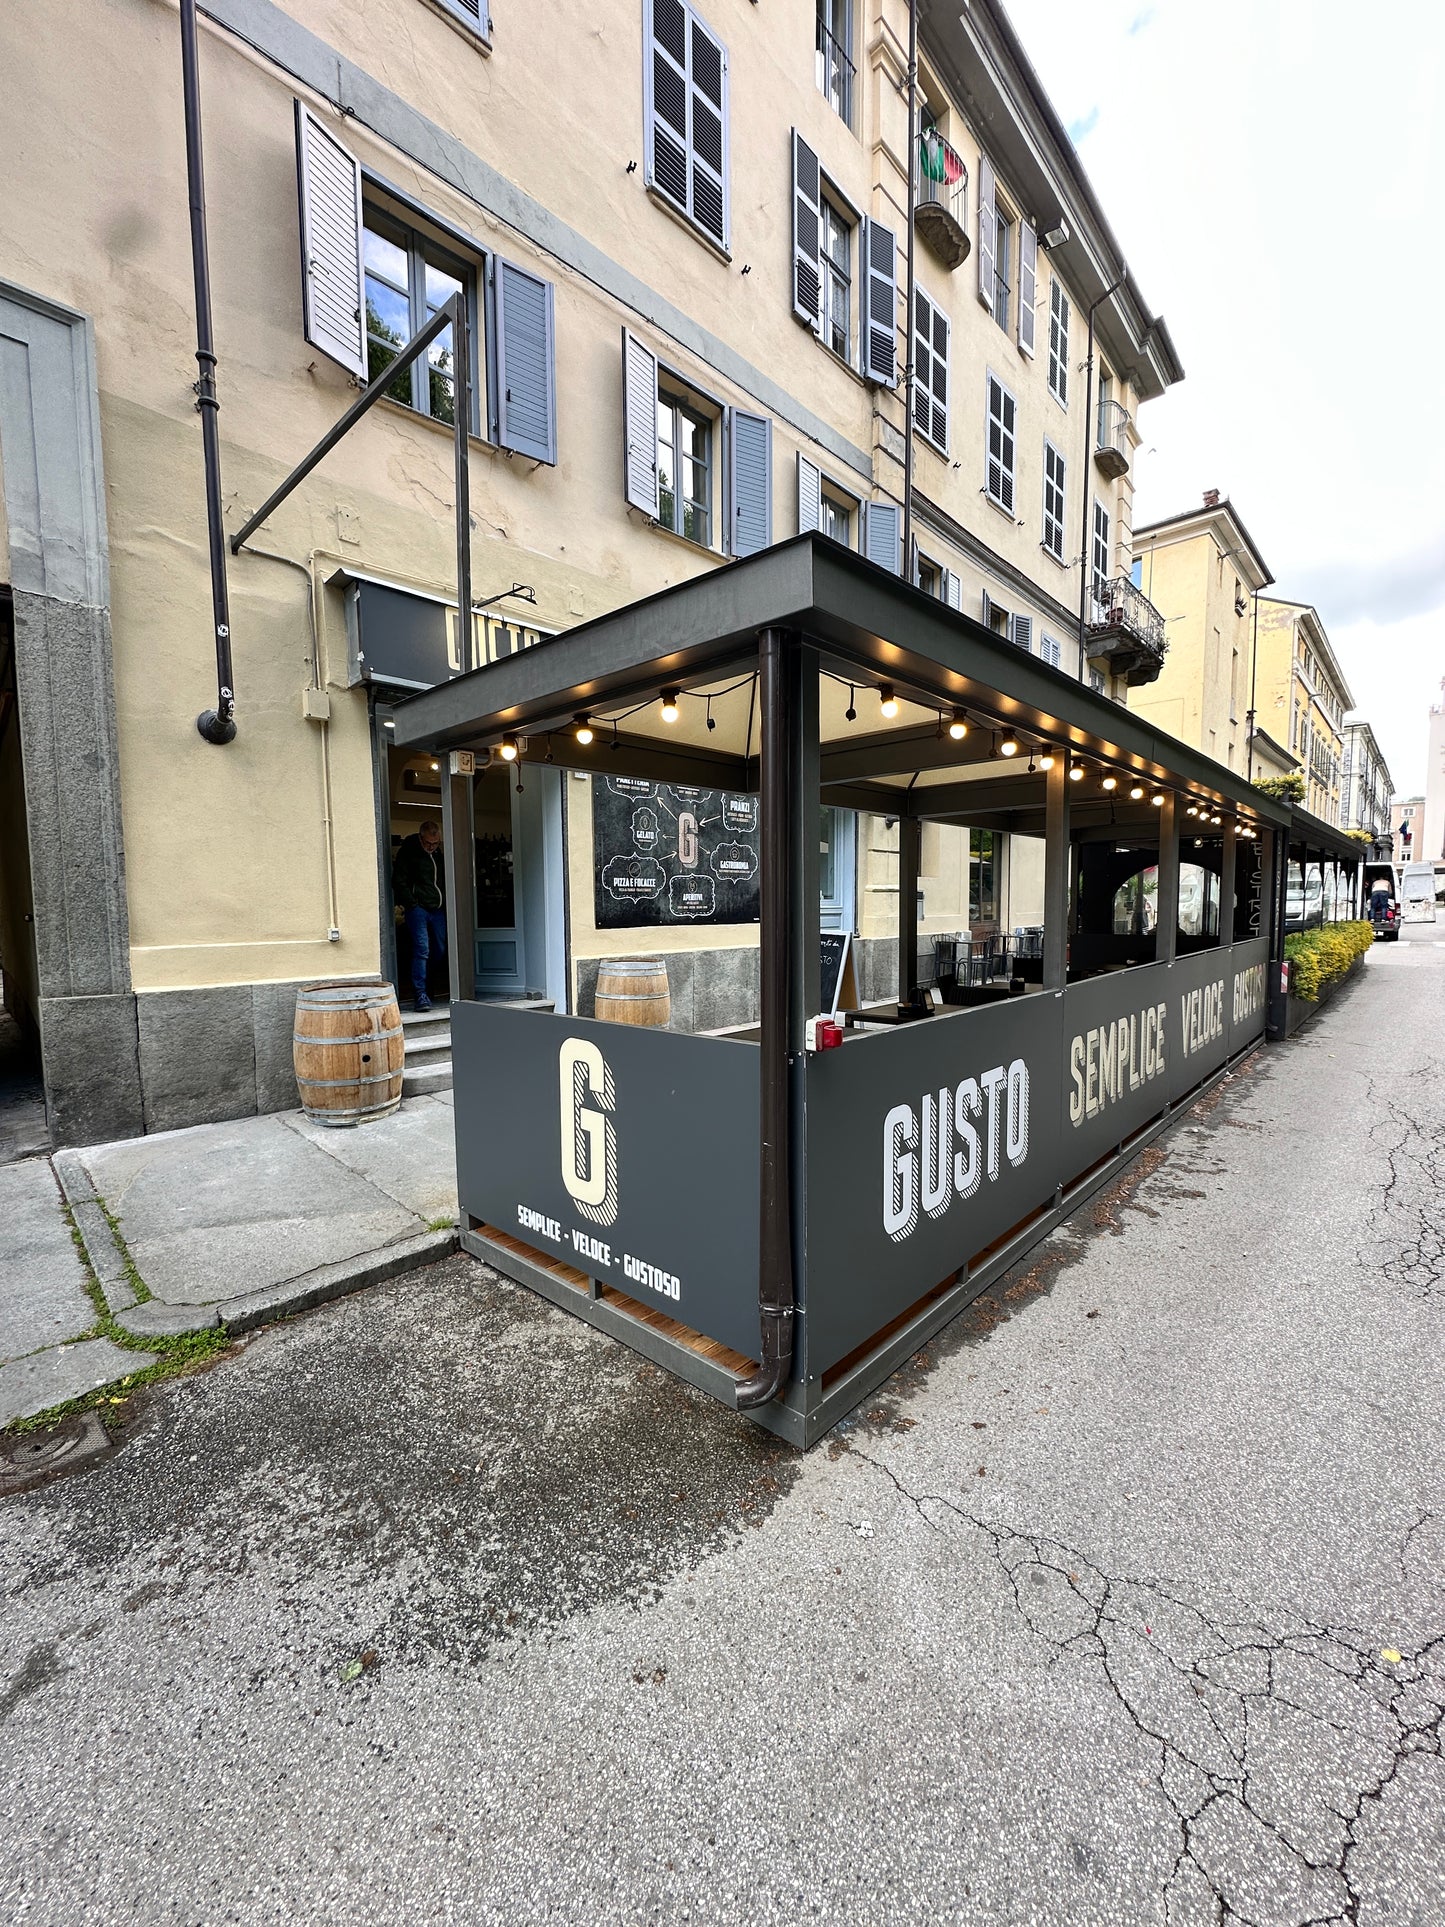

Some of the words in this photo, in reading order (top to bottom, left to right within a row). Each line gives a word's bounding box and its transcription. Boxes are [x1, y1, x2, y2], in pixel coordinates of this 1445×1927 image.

[445, 606, 541, 671] GUST
[636, 831, 654, 840] GELATO
[678, 812, 698, 868] G
[613, 877, 630, 887] PIZZA
[559, 1037, 618, 1227] G
[883, 1058, 1030, 1243] GUSTO
[1069, 1002, 1167, 1128] SEMPLICE
[1182, 979, 1225, 1059] VELOCE
[517, 1203, 561, 1242] SEMPLICE
[571, 1228, 611, 1267] VELOCE
[623, 1252, 681, 1301] GUSTOSO
